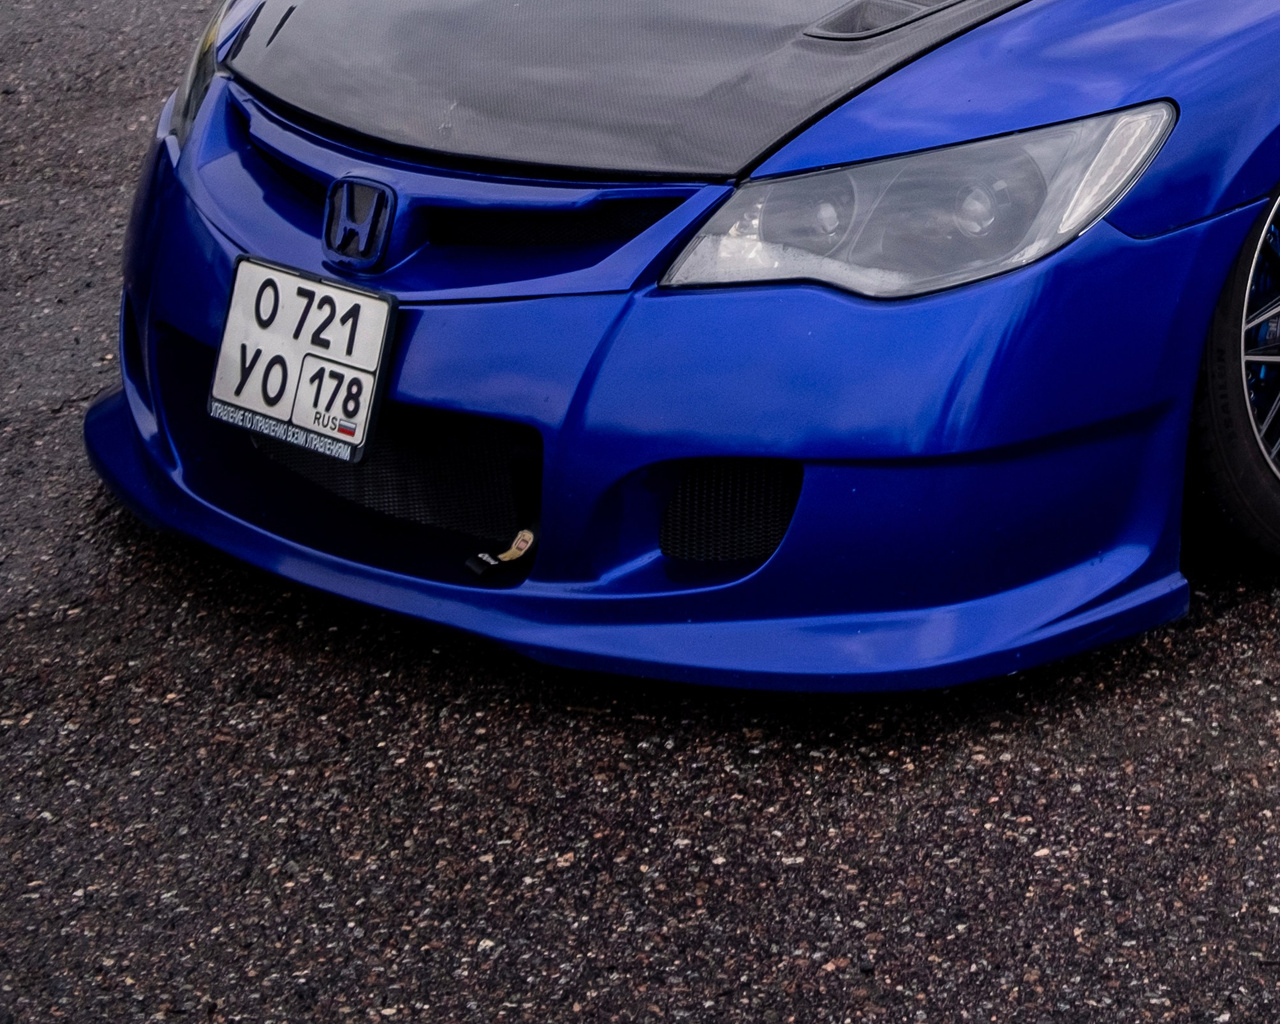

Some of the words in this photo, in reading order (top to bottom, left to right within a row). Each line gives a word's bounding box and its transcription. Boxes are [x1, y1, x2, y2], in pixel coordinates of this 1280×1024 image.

[292, 286, 361, 357] 721
[309, 366, 363, 419] 178
[313, 411, 339, 432] RUS
